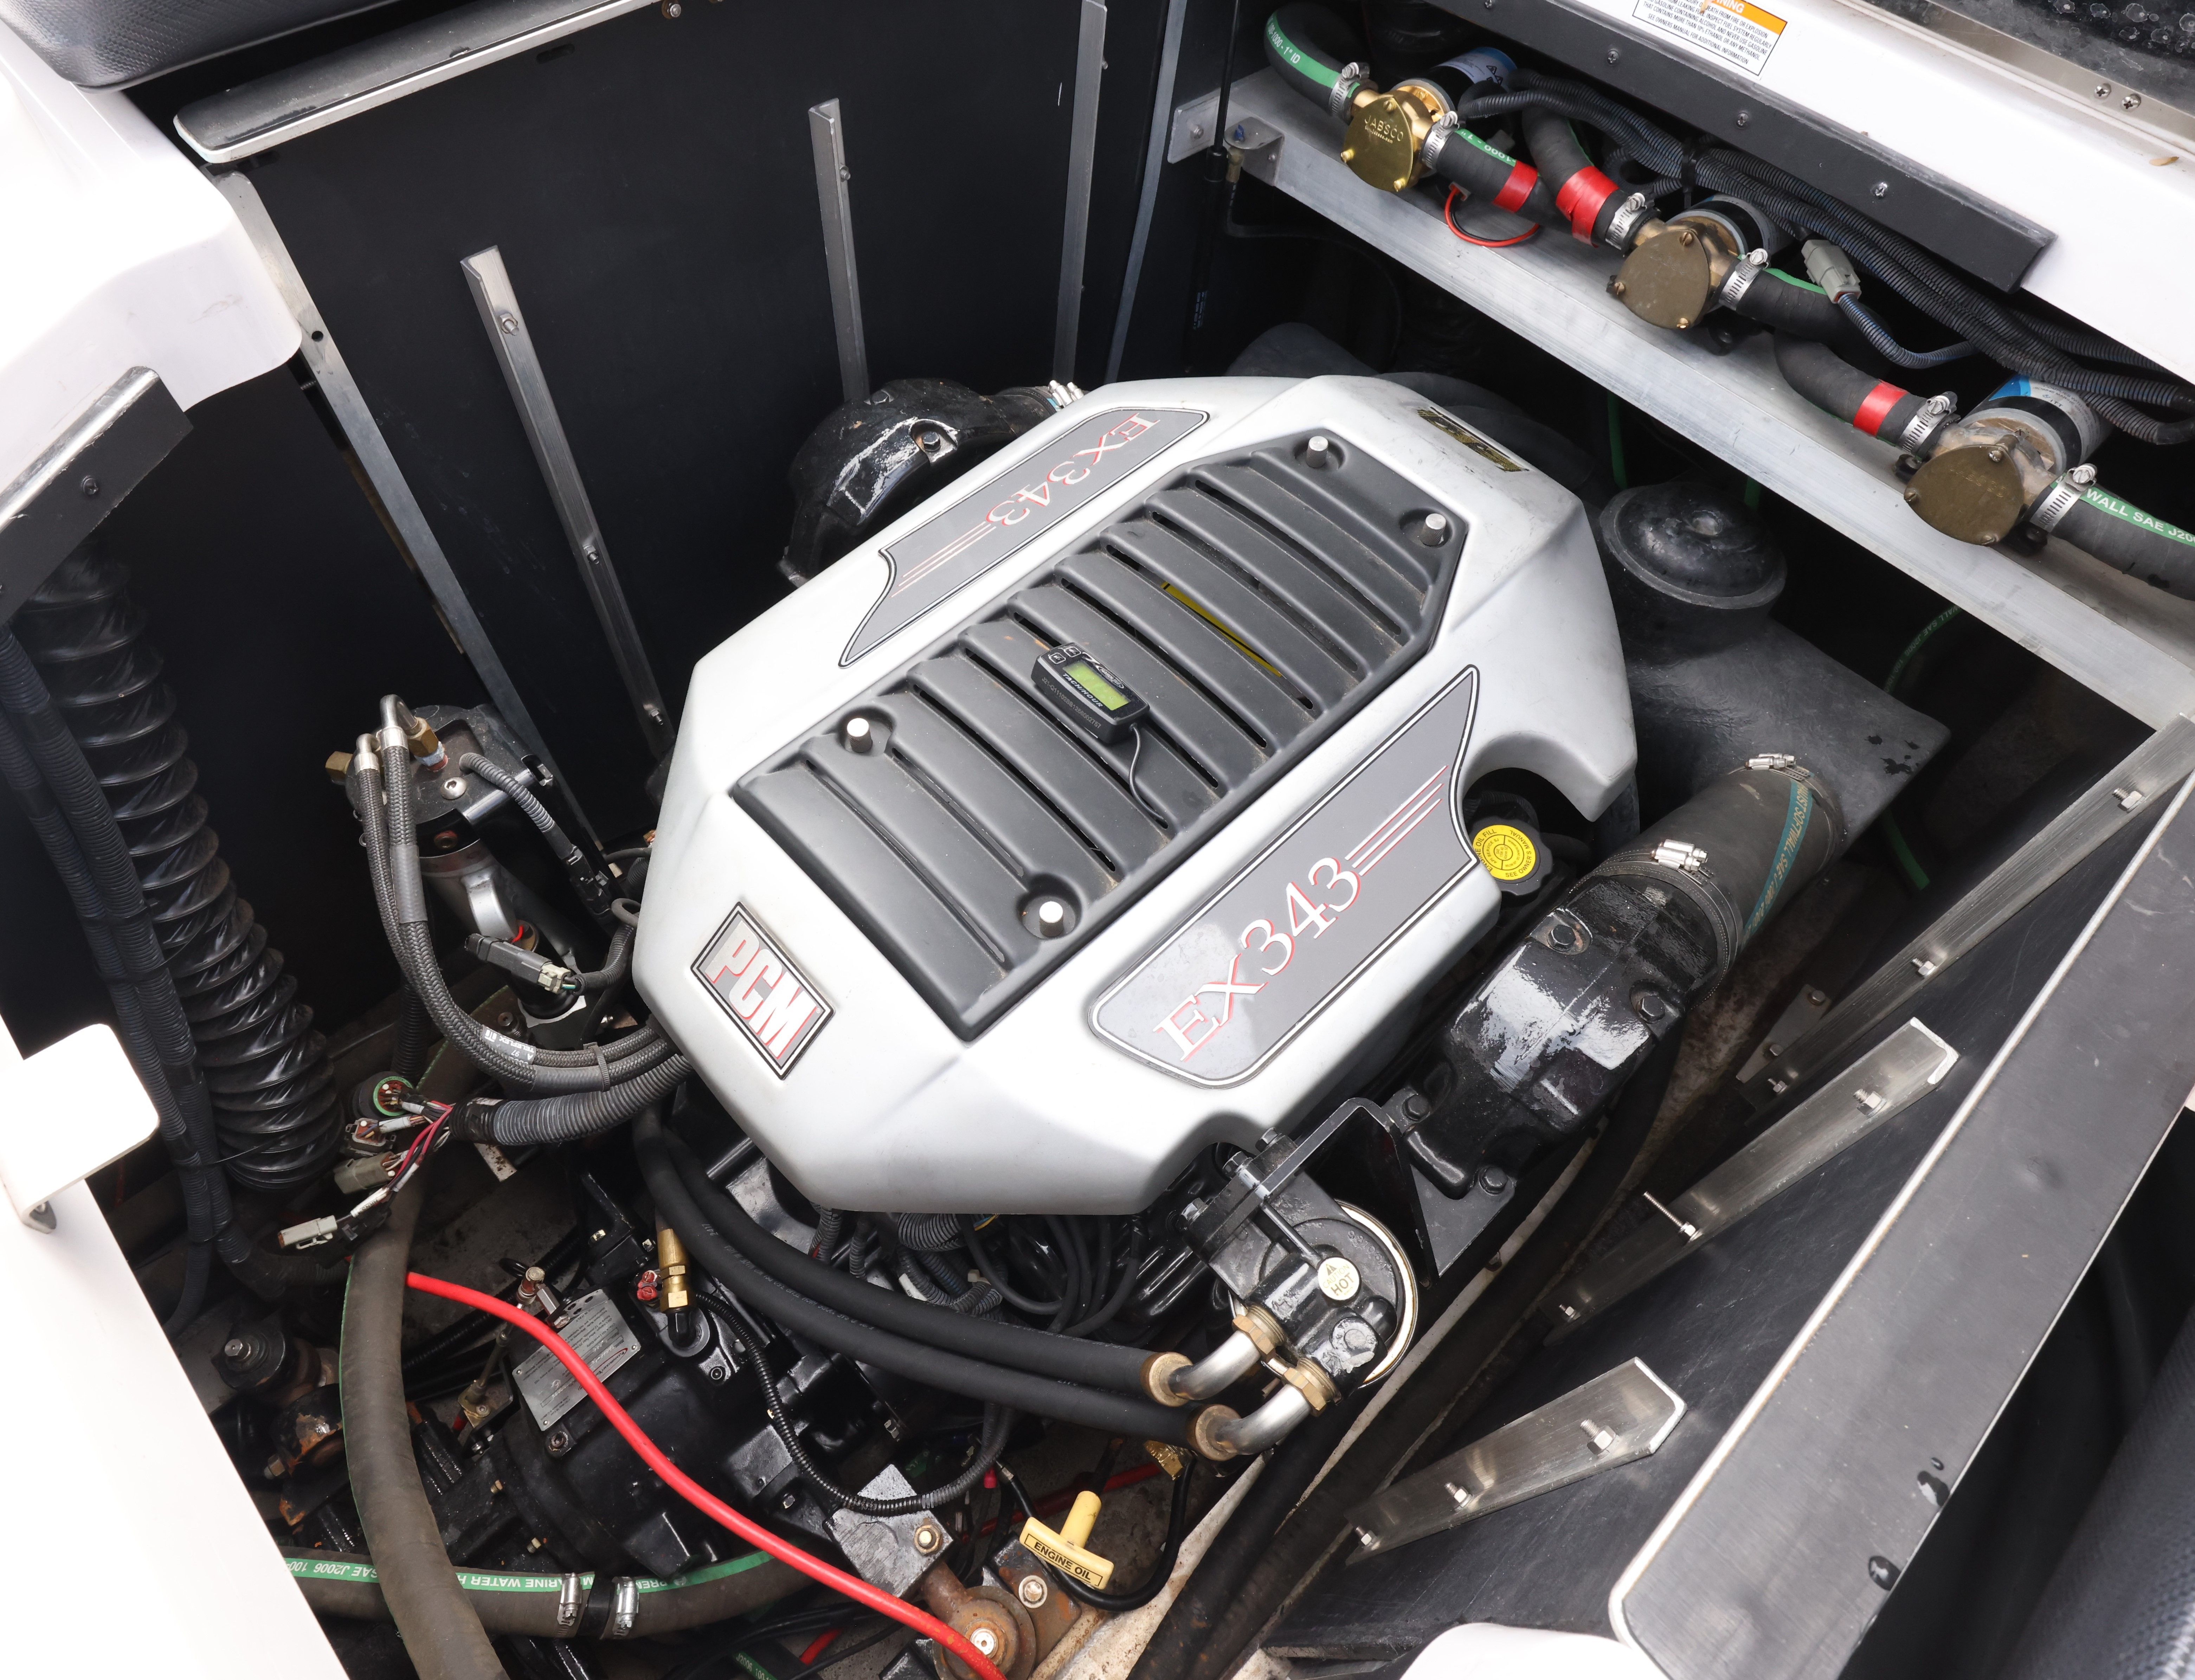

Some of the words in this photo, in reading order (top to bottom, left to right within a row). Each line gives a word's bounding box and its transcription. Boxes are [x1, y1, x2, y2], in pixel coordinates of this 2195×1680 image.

[1643, 1, 1654, 10] THAT
[1653, 5, 1674, 19] CONTAINS
[1673, 14, 1686, 24] MORE
[1685, 19, 1697, 29] THAN
[1696, 25, 1705, 33] 10%
[1704, 28, 1724, 41] ETHANOL
[1729, 40, 1739, 49] ANY
[1674, 6, 1699, 22] CONTAINING
[1698, 17, 1717, 30] ALCOHOL
[1716, 26, 1727, 34] AND
[1725, 31, 1740, 41] NEVER
[1739, 37, 1748, 45] USE
[1747, 41, 1768, 56] GASOLINE
[1677, 0, 1695, 13] LEAKING
[1705, 13, 1723, 25] INSPECT
[1723, 21, 1733, 29] FUEL
[1732, 25, 1750, 38] SYSTEM
[1718, 11, 1731, 20] FROM
[1730, 16, 1740, 25] FIRE
[1745, 24, 1769, 39] EXPLOSION
[1647, 13, 1656, 21] SEE
[1655, 16, 1673, 28] OWNERS
[1672, 24, 1691, 36] MANUAL
[1689, 32, 1699, 40] FOR
[1698, 36, 1722, 51] ADDITIONAL
[1720, 47, 1749, 64] INFORMATION
[1290, 53, 1300, 64] ID
[1365, 115, 1403, 141] JABSCO
[986, 412, 1161, 526] EX343
[2086, 488, 2128, 517] WALL
[2133, 511, 2164, 532] SAE
[1062, 673, 1103, 707] TACH/HOUR
[1476, 837, 1485, 847] OIL
[1482, 829, 1497, 838] FILL
[1510, 830, 1530, 849] MANUAL
[1519, 851, 1532, 874] OWNER'S
[704, 920, 817, 1060] PCM
[498, 1035, 534, 1053] TELEFLEX
[1323, 1263, 1350, 1288] CAUTION
[1331, 1272, 1354, 1296] HOT
[313, 1563, 350, 1575] J2006
[351, 1566, 377, 1578] SAE
[1034, 1541, 1073, 1570] ENGINE
[1074, 1566, 1091, 1581] OIL
[471, 1576, 521, 1588] WATER
[525, 1576, 594, 1588] MRINE
